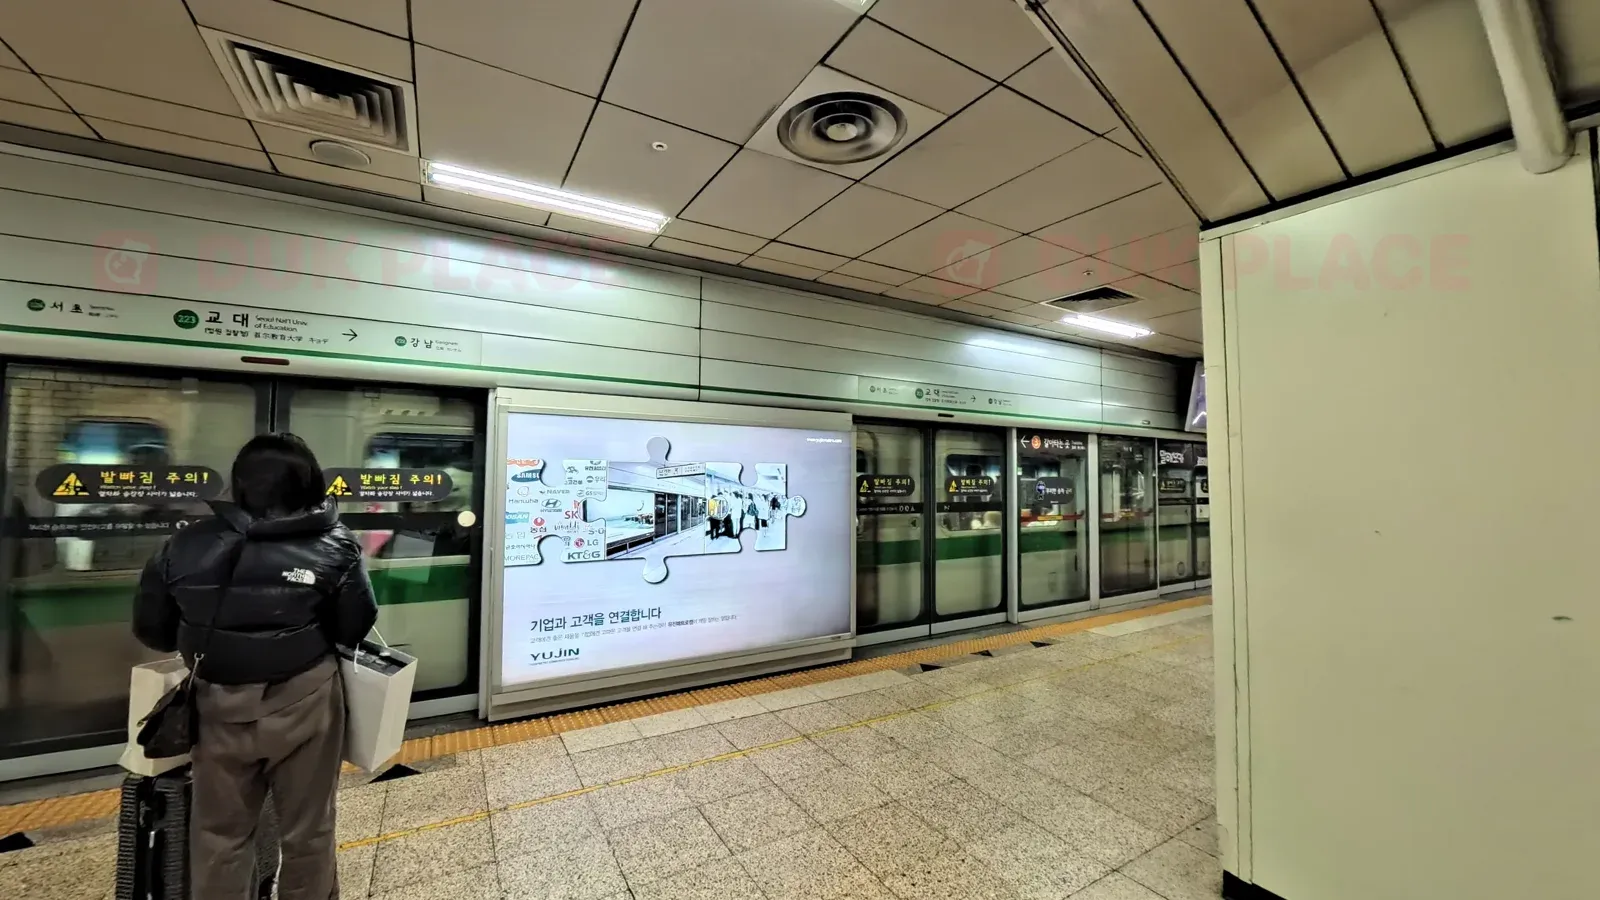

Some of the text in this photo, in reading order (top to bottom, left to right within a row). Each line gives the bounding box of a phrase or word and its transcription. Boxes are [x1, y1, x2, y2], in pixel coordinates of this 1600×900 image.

[205, 311, 249, 328] 교대
[255, 315, 275, 323] Seoul
[262, 323, 298, 332] Education
[410, 337, 434, 349] 강남
[100, 471, 209, 484] 발빠짐 주의!
[360, 473, 442, 485] 발빠짐 주의!
[564, 510, 578, 519] SK
[587, 539, 599, 547] LG
[567, 550, 601, 560] KT&G
[530, 606, 662, 633] 기업과 고객을 연결합니다
[530, 647, 580, 661] YUJIN
